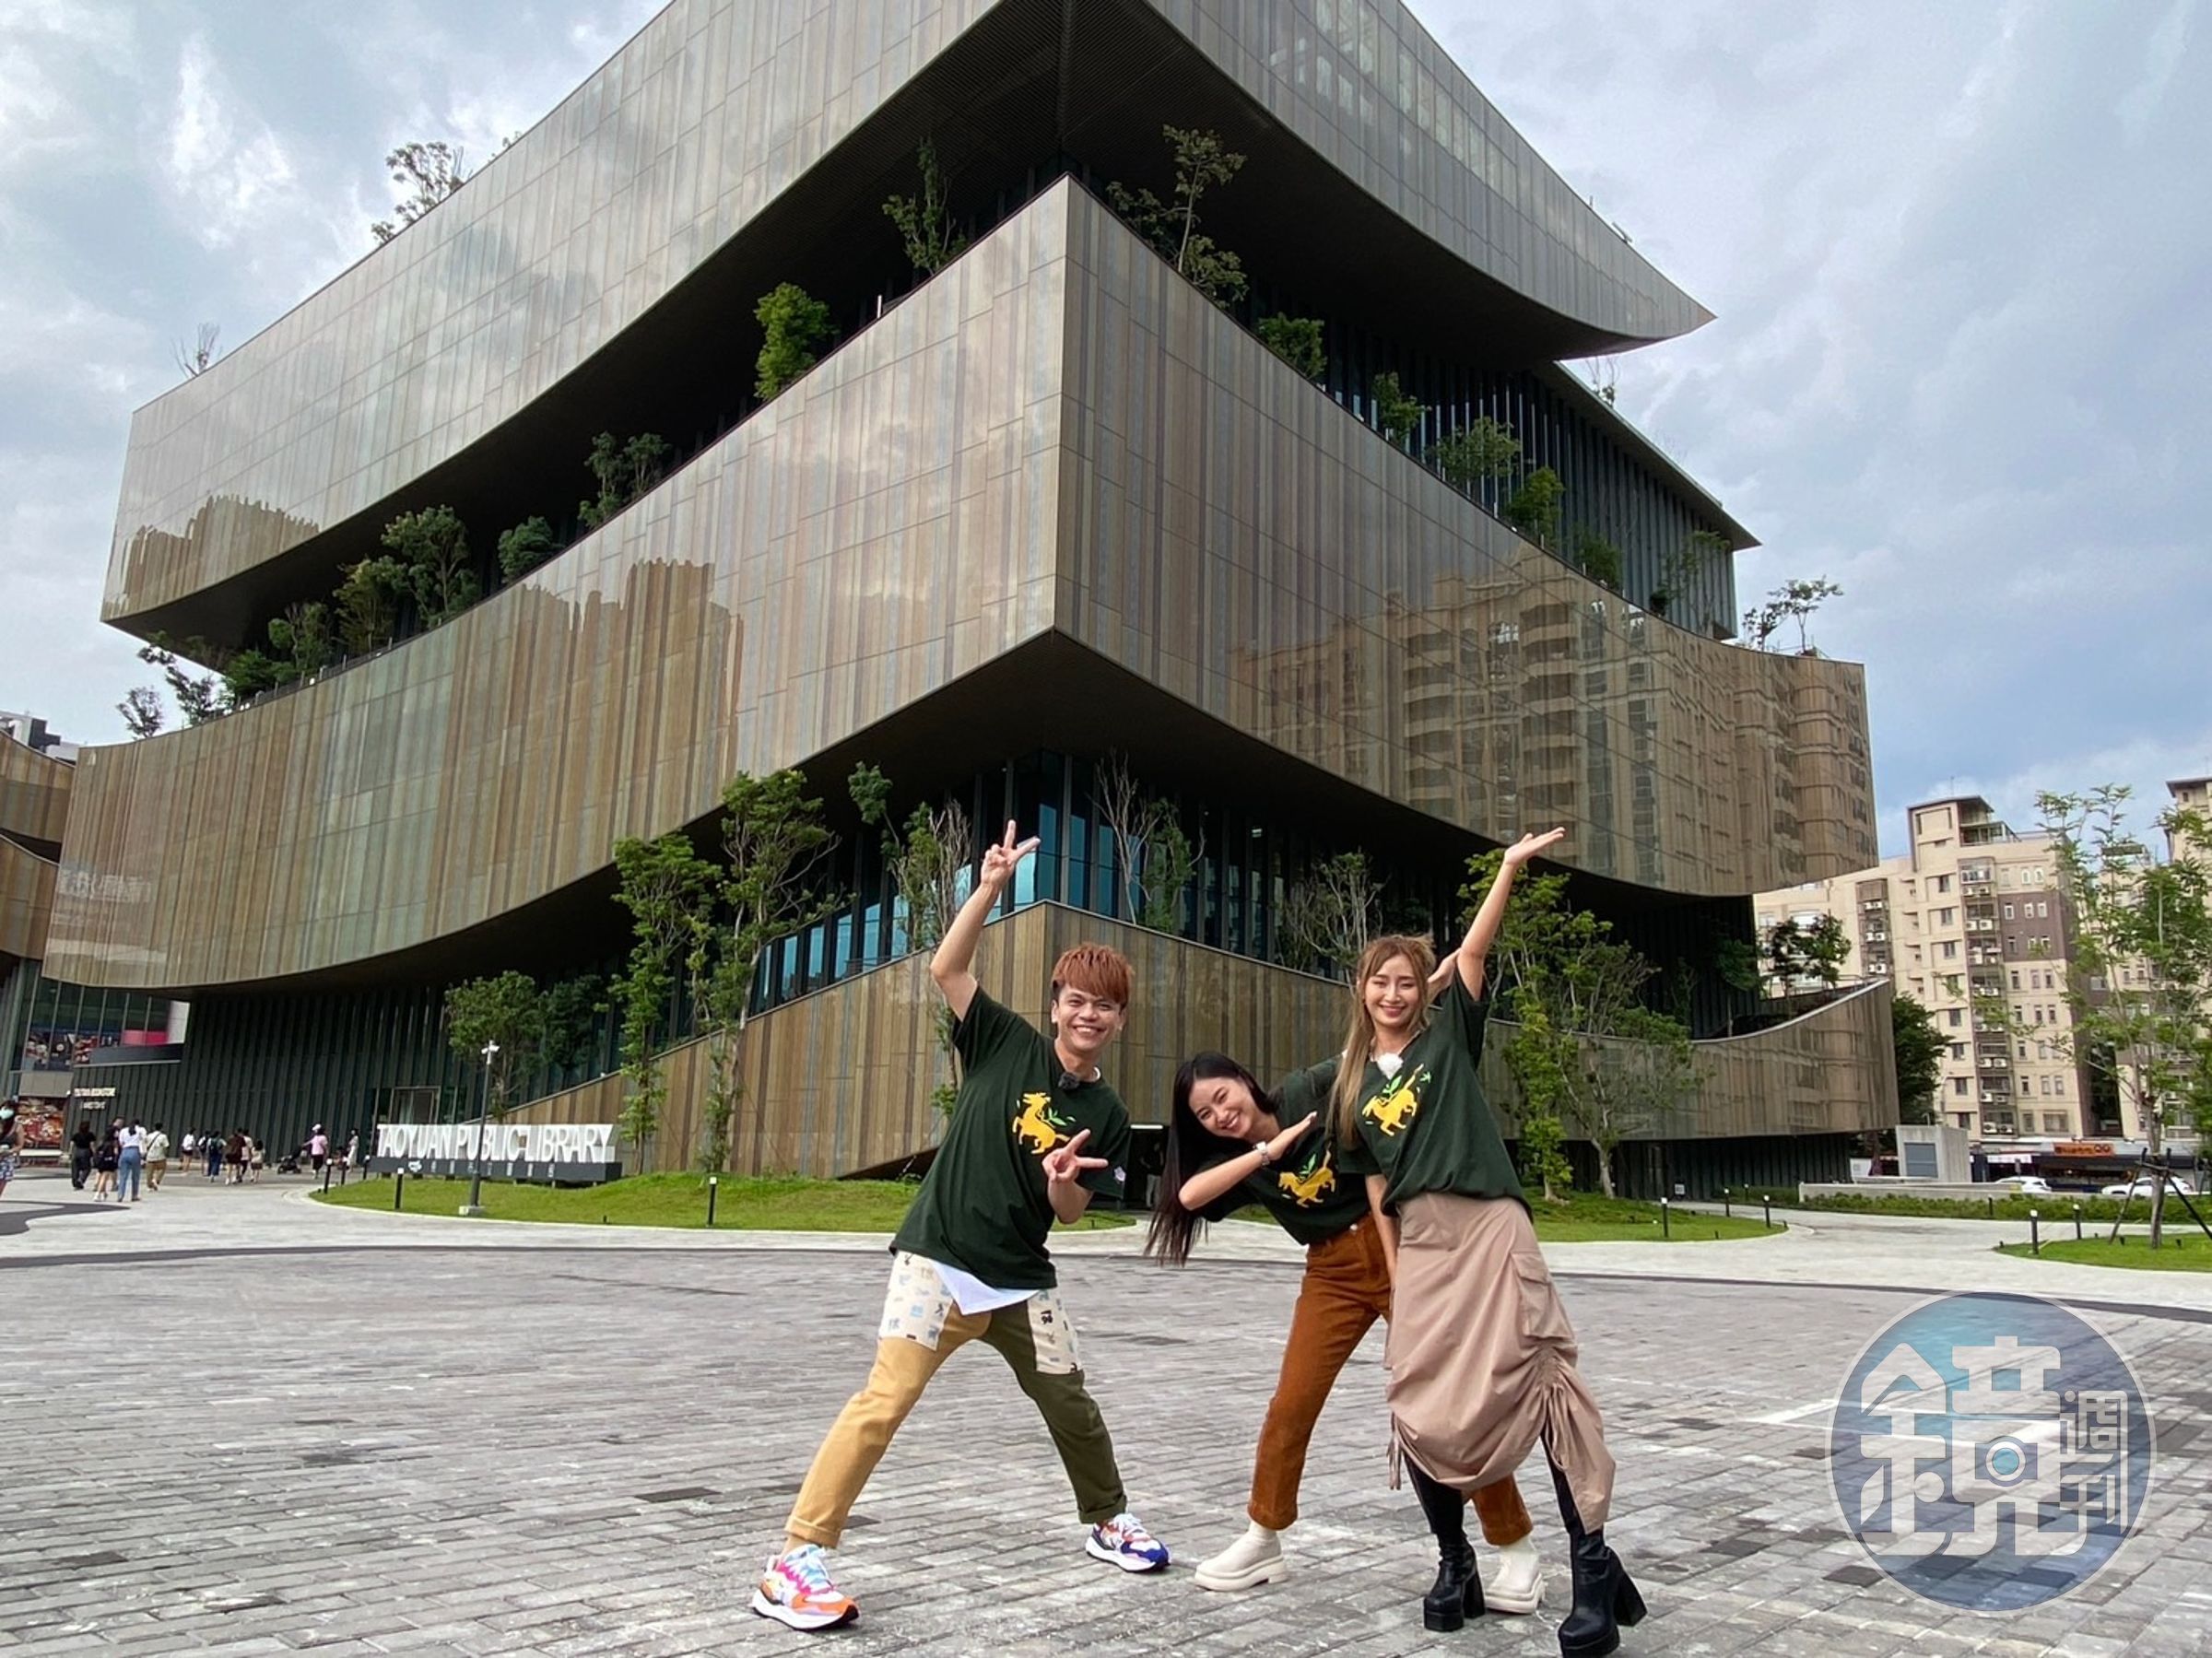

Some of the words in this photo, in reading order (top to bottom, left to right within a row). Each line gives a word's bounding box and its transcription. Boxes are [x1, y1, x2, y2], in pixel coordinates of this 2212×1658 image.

[377, 1123, 454, 1159] TAOYUAN
[454, 1123, 523, 1161] PUBLIC
[524, 1123, 613, 1163] LIBRARY
